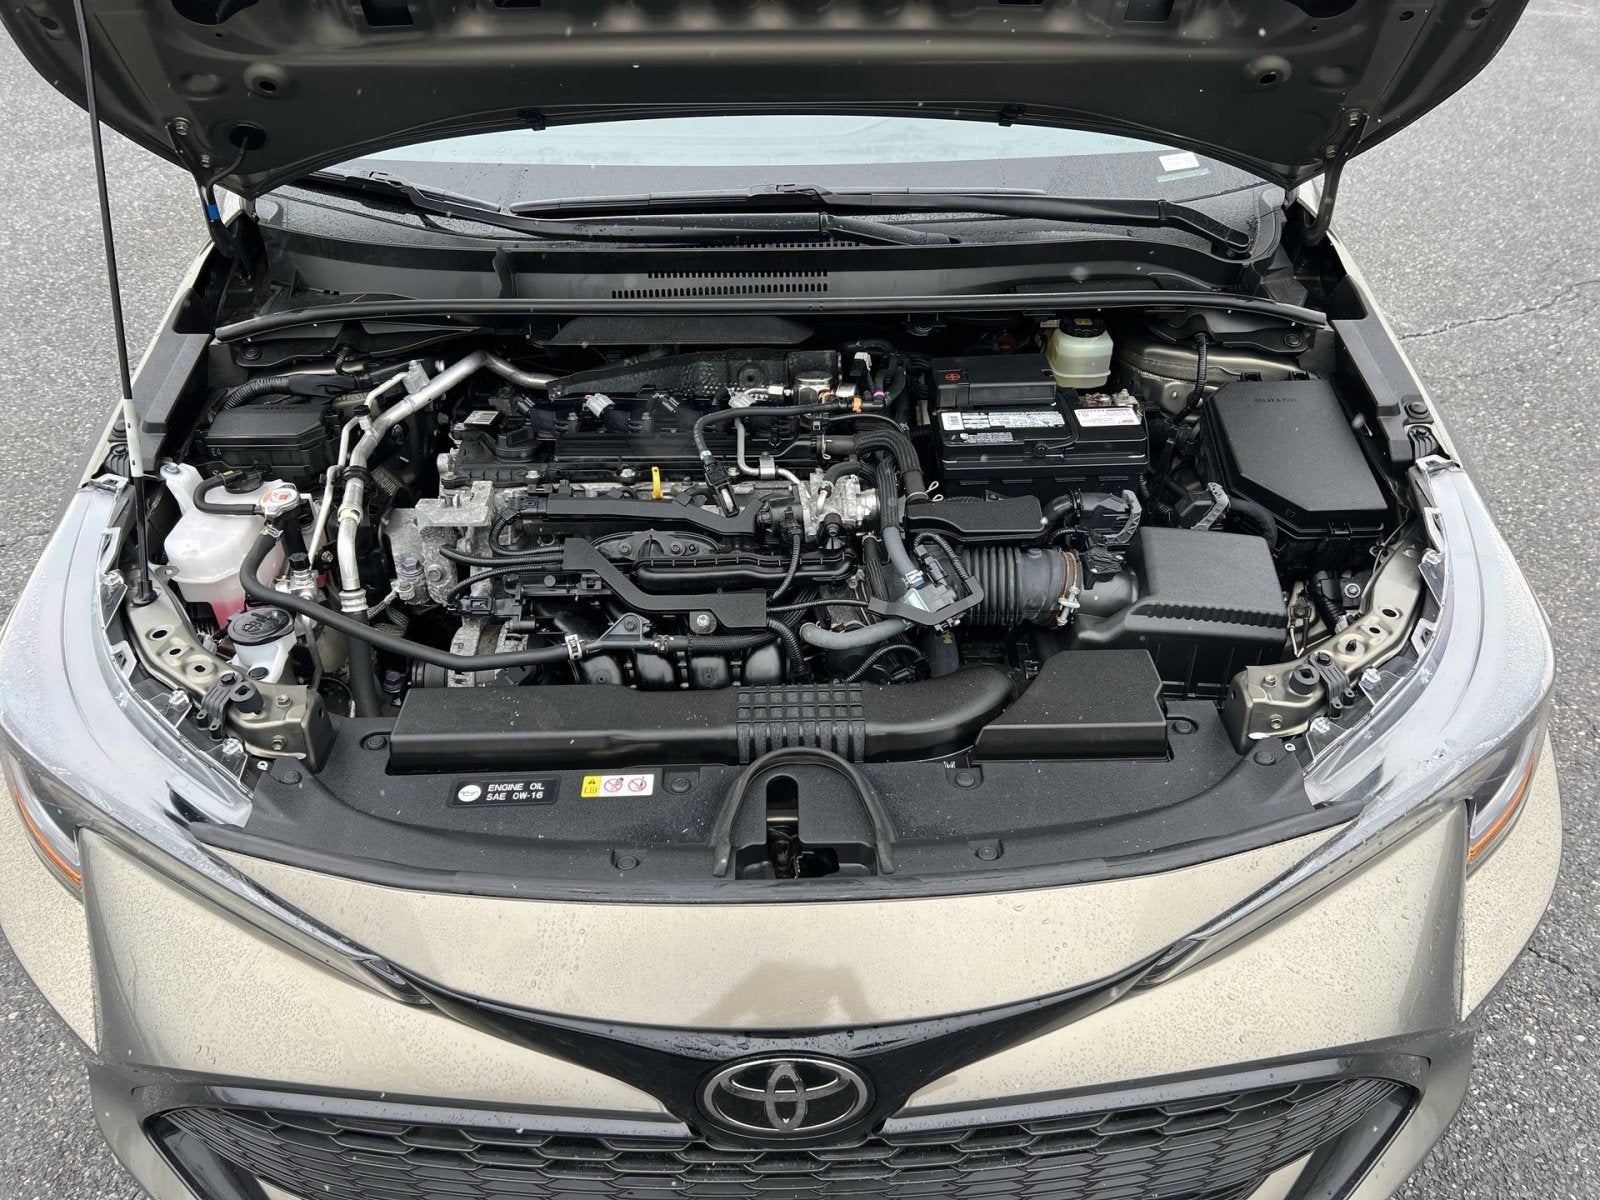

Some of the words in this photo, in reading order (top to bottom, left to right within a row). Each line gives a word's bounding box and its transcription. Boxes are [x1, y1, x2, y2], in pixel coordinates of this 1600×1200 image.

[487, 783, 524, 792] ENGINE
[529, 782, 545, 790] OIL
[486, 793, 507, 801] SAE
[512, 791, 544, 800] 0W-16
